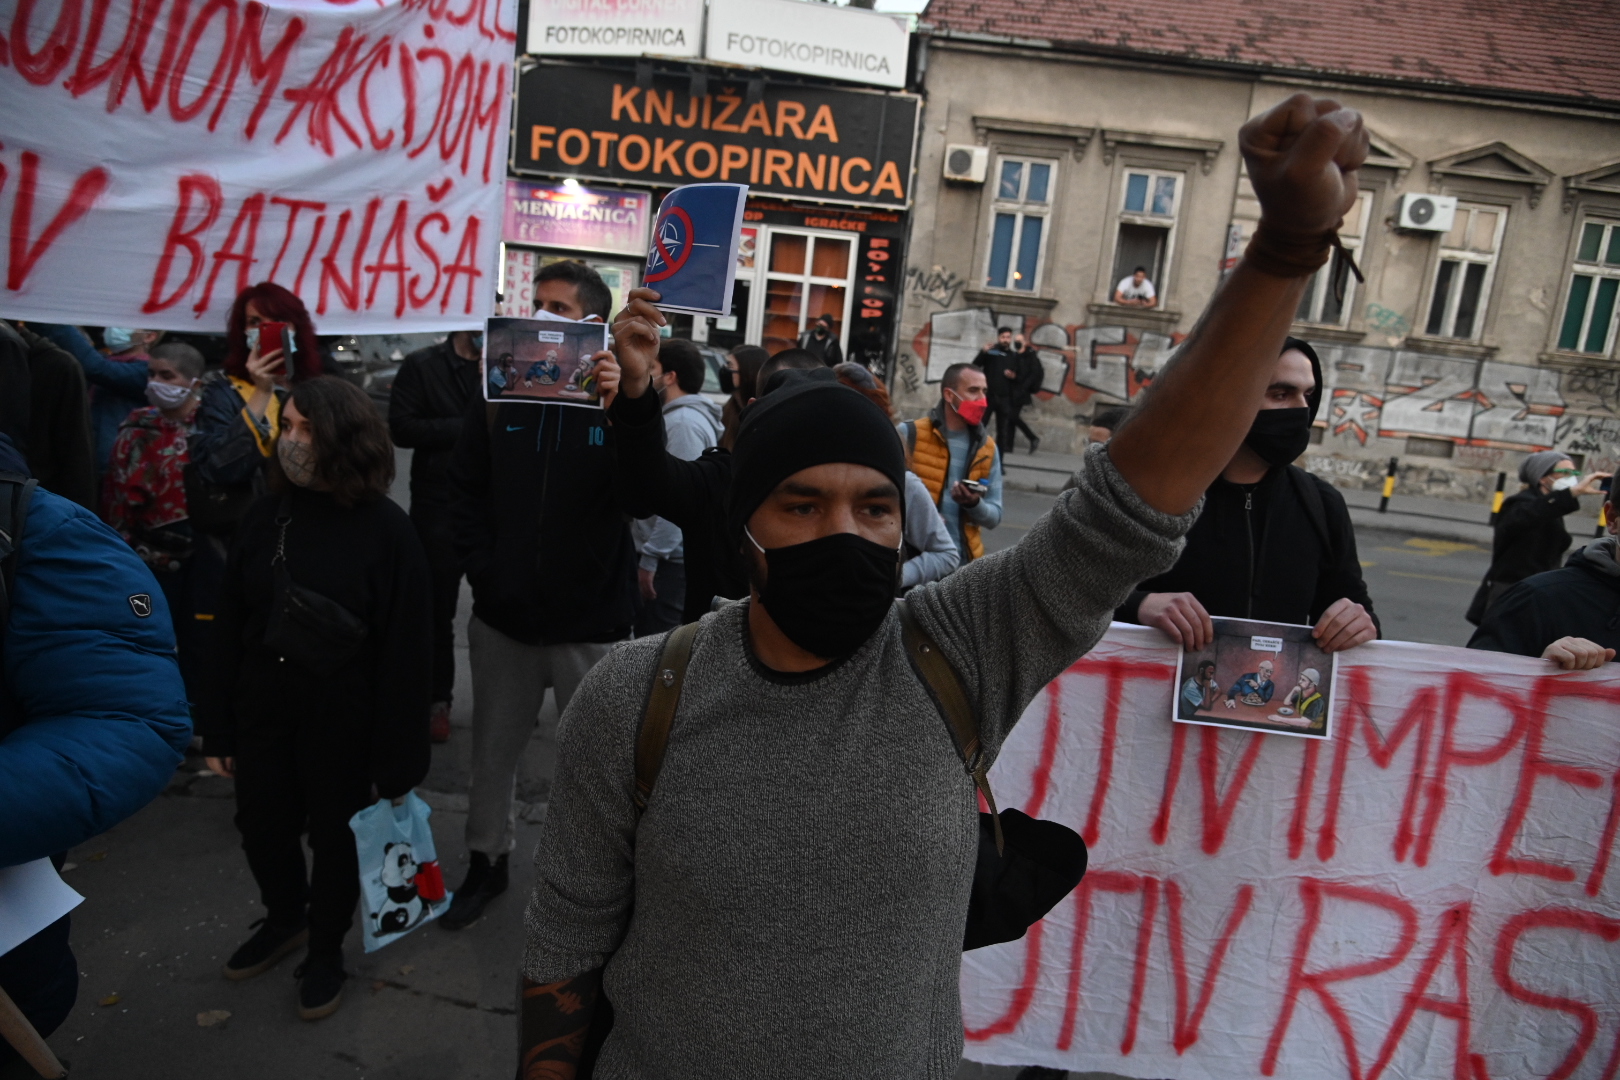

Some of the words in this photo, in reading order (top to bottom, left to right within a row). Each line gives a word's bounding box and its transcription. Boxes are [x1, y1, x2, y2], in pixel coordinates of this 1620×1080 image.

[545, 26, 686, 47] FOTOKOPIRNICA
[727, 32, 891, 75] FOTOKOPIRNICA
[611, 84, 839, 143] KNJIŽARA
[530, 124, 905, 199] FOTOKOPIRNICA
[141, 172, 483, 318] BATINAŠA
[505, 251, 518, 317] MENJA
[519, 252, 532, 317] EXCH
[588, 426, 604, 446] 10
[1260, 875, 1620, 1080] RAS
